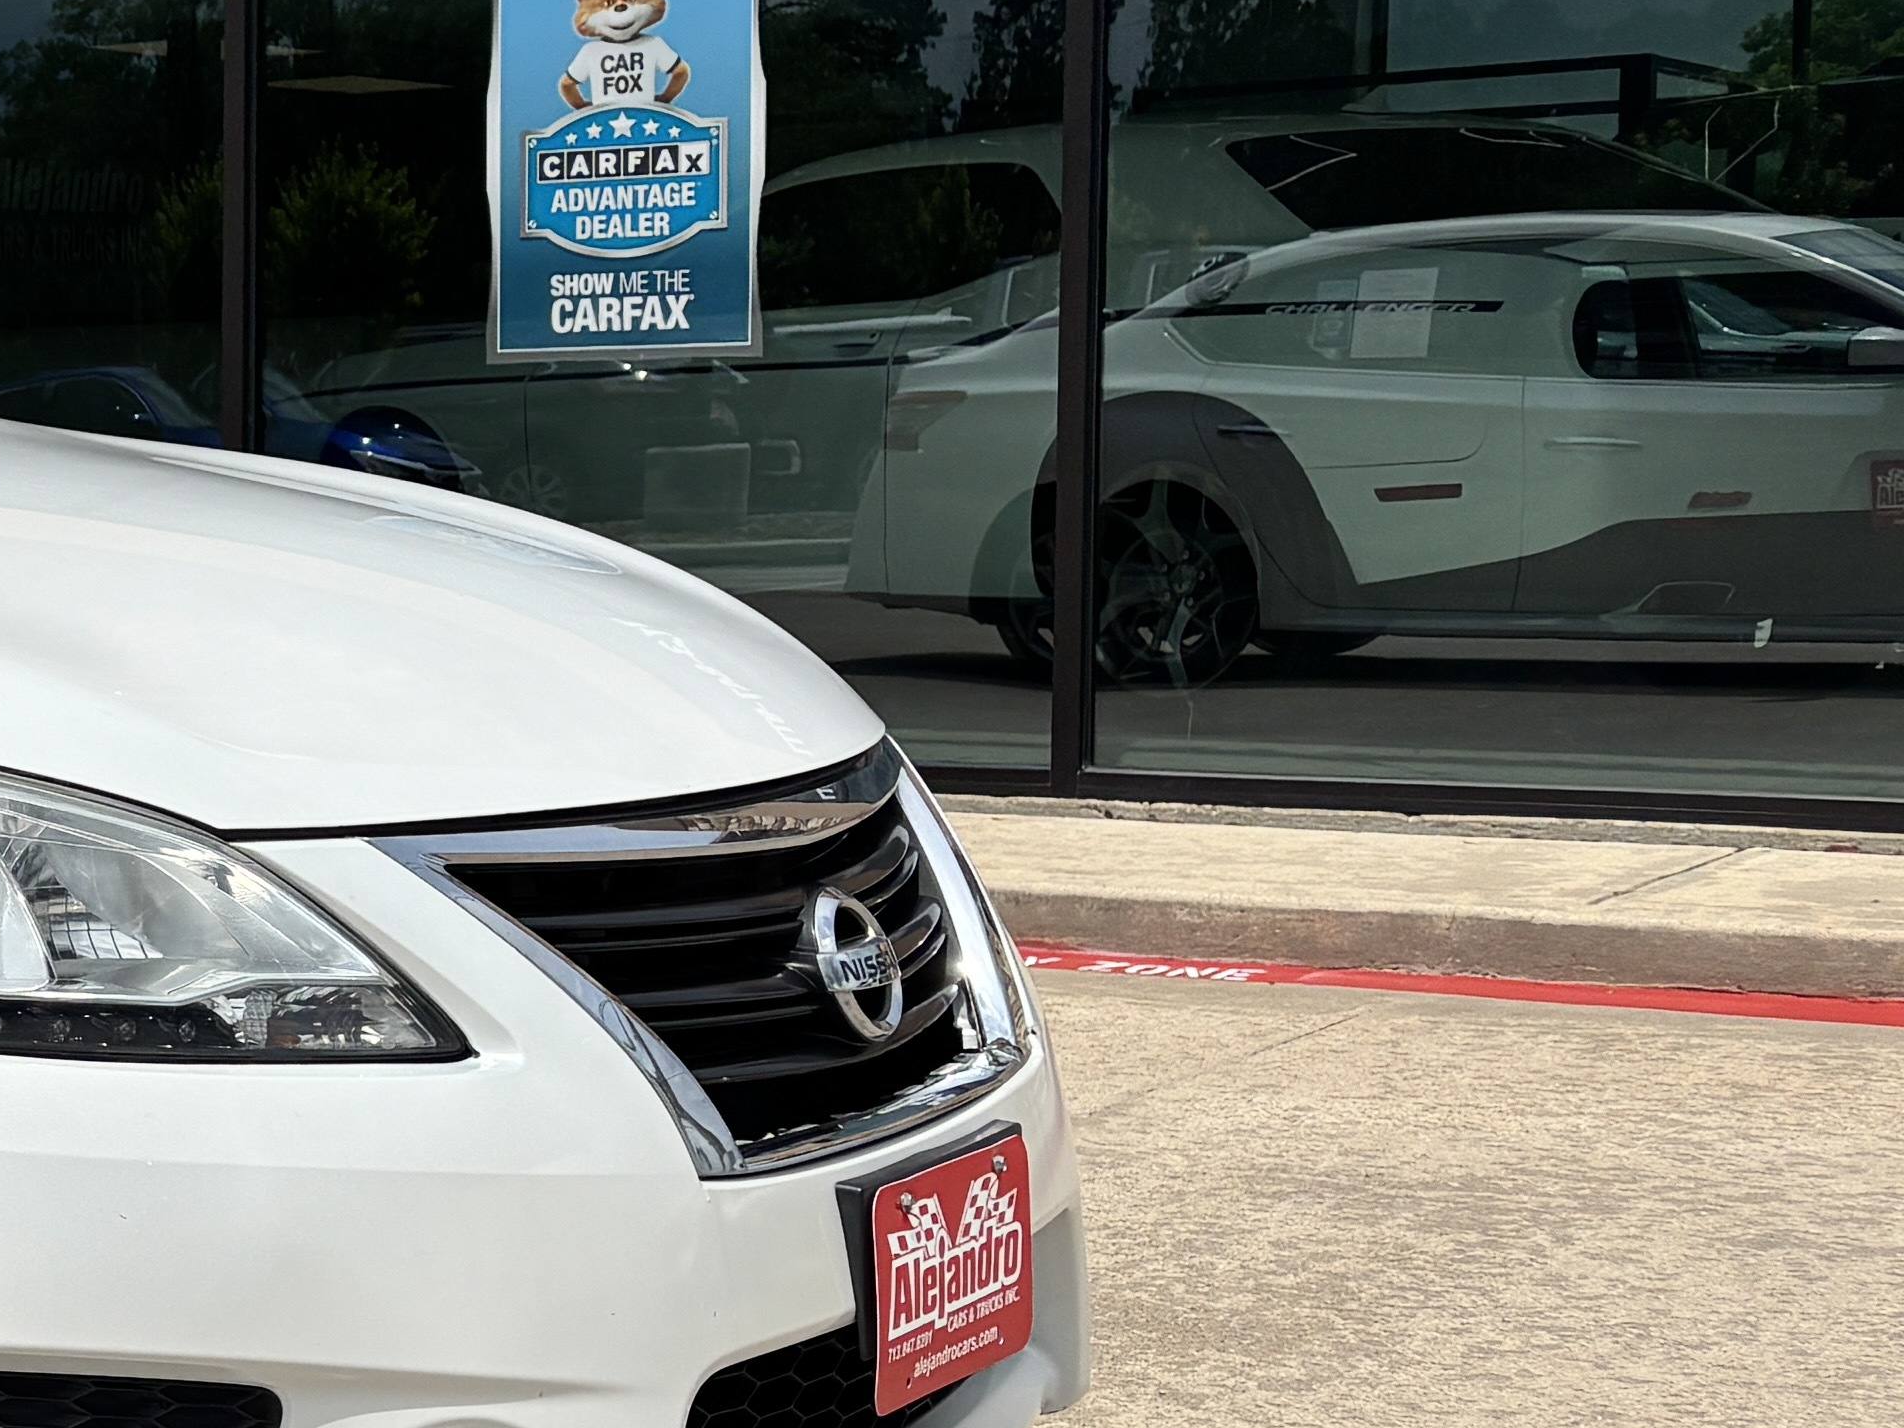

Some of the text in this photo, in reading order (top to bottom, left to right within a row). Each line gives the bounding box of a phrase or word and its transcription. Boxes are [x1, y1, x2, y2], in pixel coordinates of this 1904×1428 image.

[600, 52, 644, 74] CAR
[603, 74, 644, 96] FOX
[539, 145, 708, 181] CARFAX
[551, 182, 697, 213] ADVANTAGE
[575, 212, 671, 240] DEALER
[550, 269, 691, 297] SHOW ME THE
[550, 294, 692, 334] CARFAX
[1077, 960, 1268, 982] ZONE
[888, 1221, 1023, 1341] Alejandro
[913, 1326, 998, 1378] alejandrocars.com
